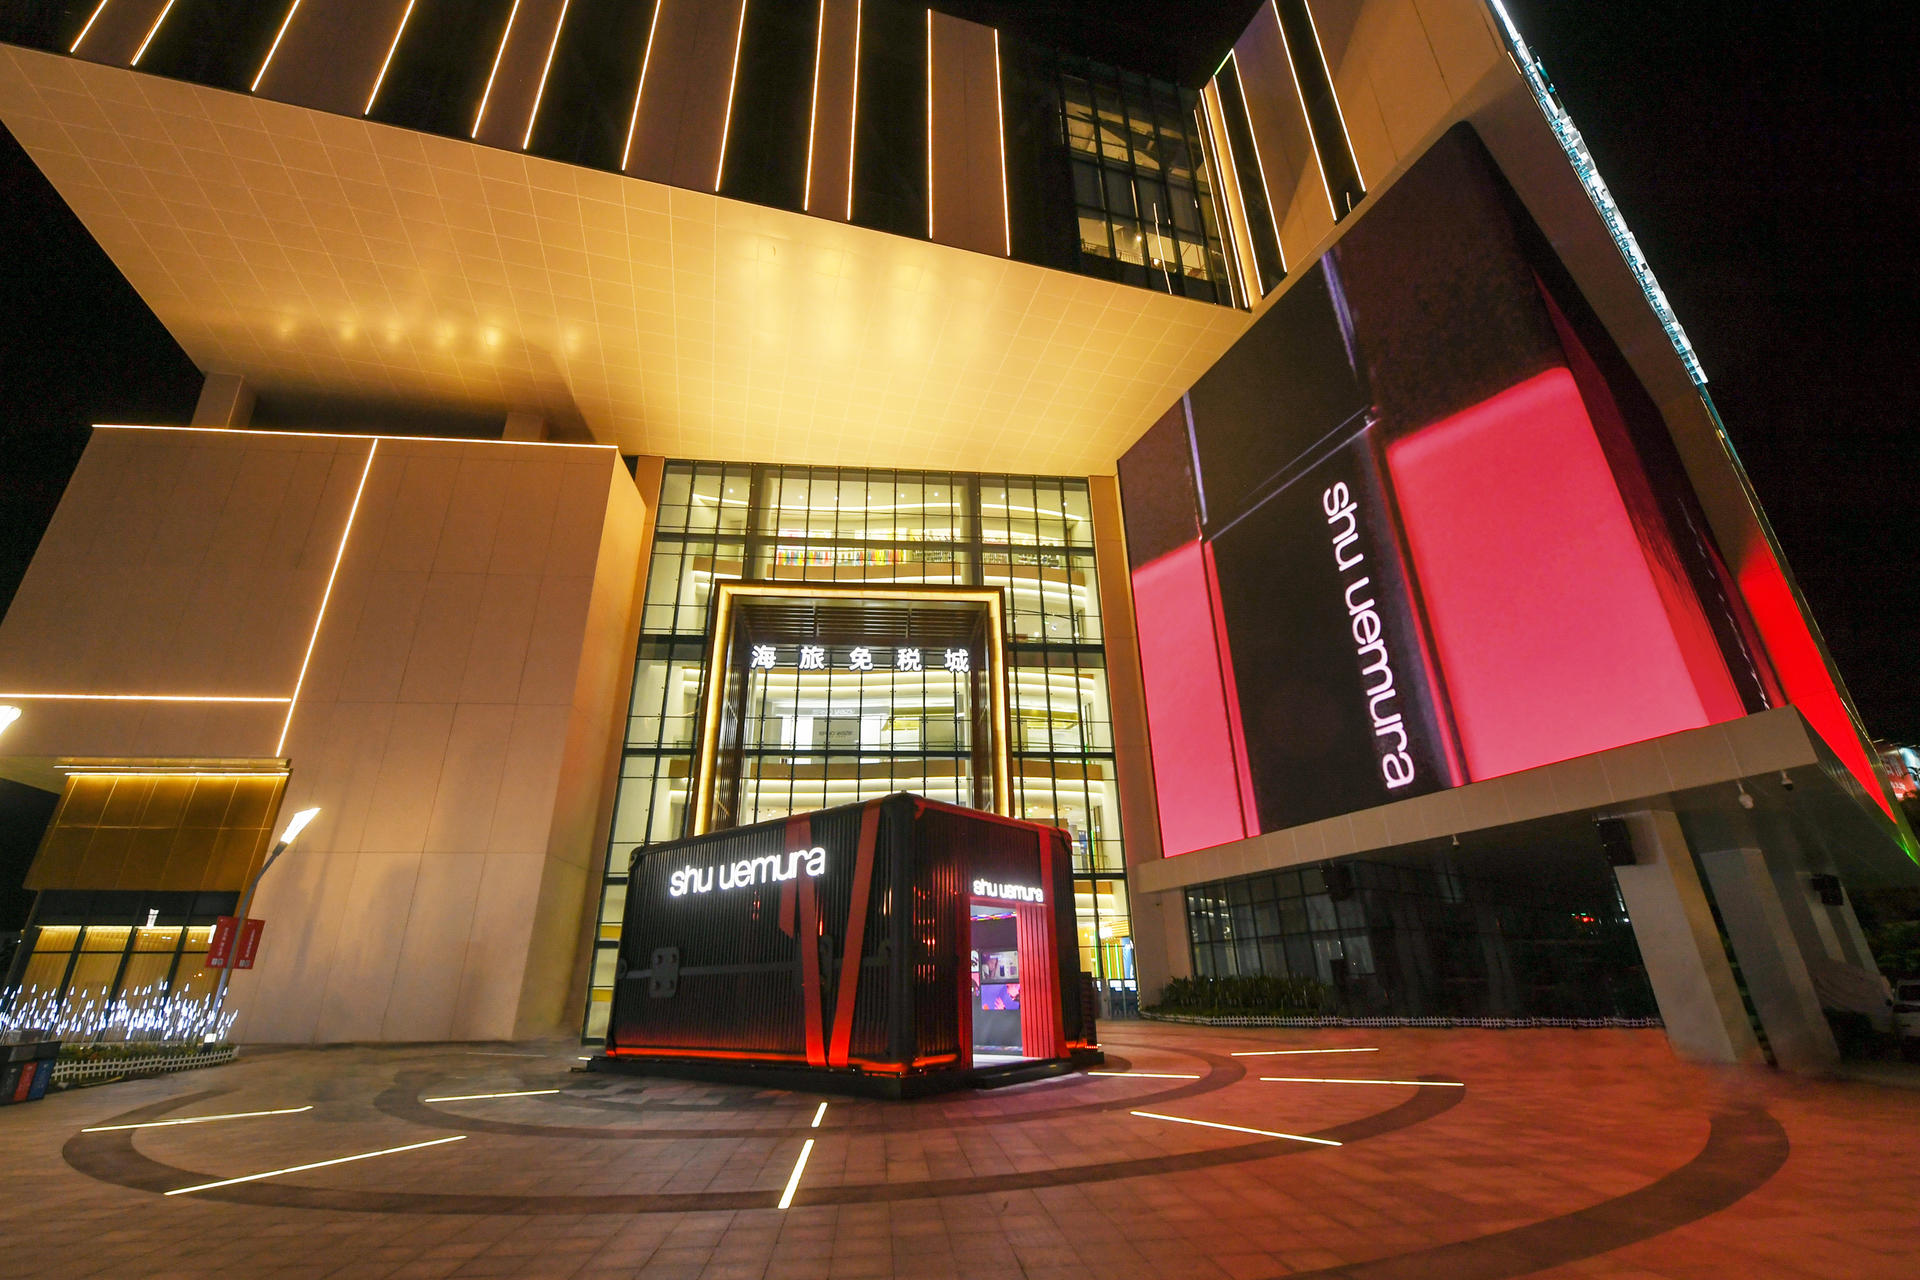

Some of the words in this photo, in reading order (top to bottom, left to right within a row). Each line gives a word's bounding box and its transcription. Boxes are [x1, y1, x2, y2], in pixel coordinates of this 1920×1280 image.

[1323, 481, 1364, 572] shu
[1345, 576, 1415, 789] uemura
[751, 645, 969, 672] 海旅免税城
[669, 865, 713, 897] shu
[719, 847, 826, 890] uemura
[973, 878, 997, 897] shu
[998, 883, 1044, 903] uemura
